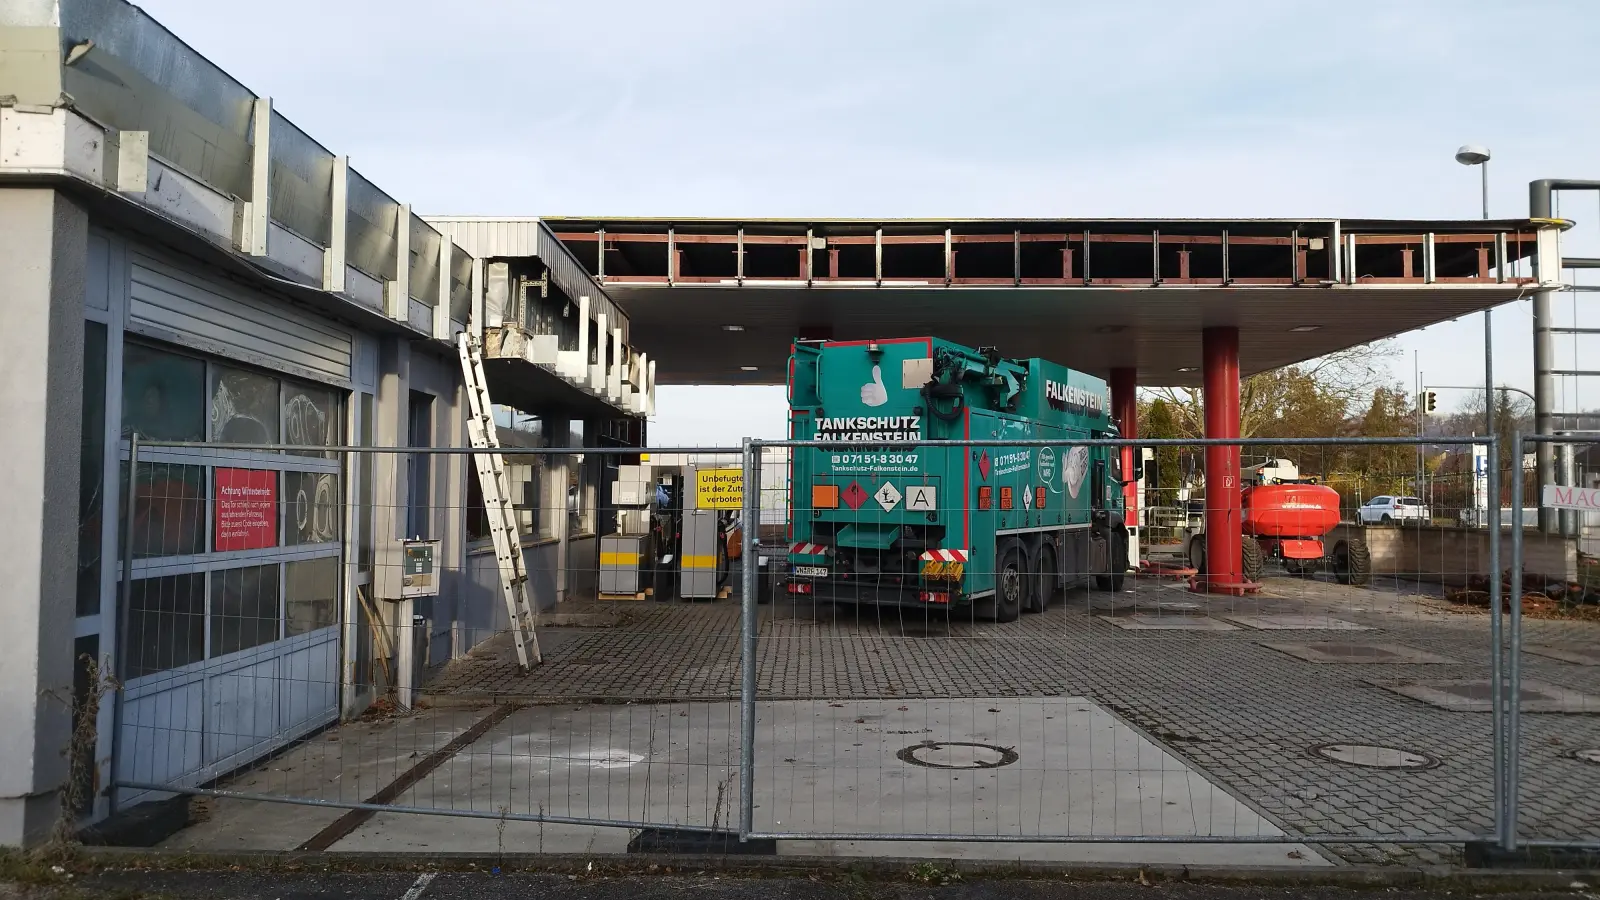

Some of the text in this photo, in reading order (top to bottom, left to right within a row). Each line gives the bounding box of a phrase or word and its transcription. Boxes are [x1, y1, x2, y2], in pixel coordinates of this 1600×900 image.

[1046, 380, 1103, 411] FALKENSTEIN
[814, 416, 921, 430] TANKSCHUTZ
[813, 431, 921, 441] FALKENSTEIN
[905, 455, 918, 464] 47
[221, 486, 241, 496] Achtung
[712, 485, 725, 493] der
[912, 489, 930, 507] A
